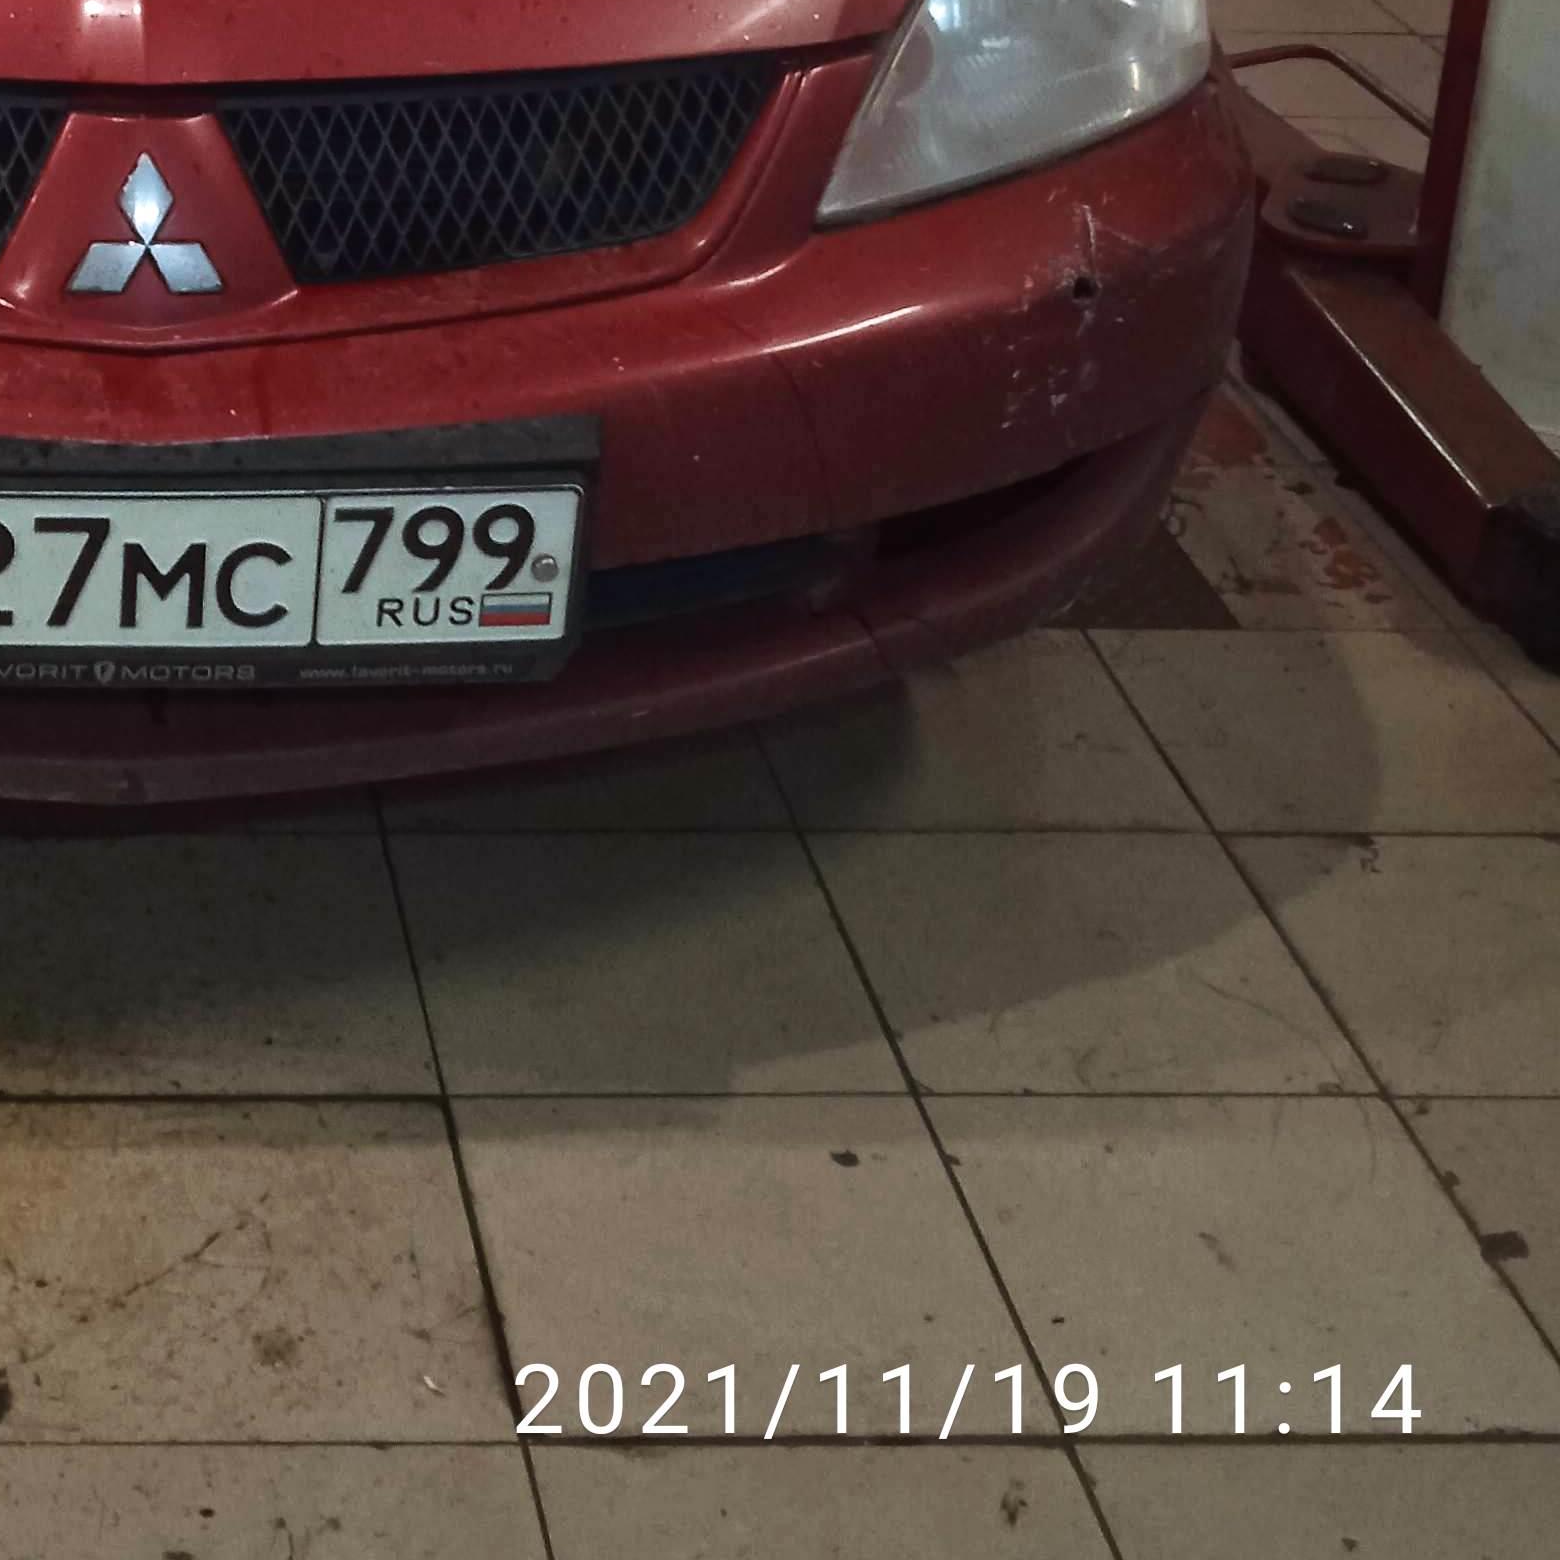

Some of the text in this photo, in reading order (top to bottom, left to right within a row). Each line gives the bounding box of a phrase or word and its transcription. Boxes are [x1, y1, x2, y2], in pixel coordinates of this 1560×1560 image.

[333, 504, 536, 595] 799
[376, 595, 474, 628] RUS
[121, 664, 256, 681] MOTORS
